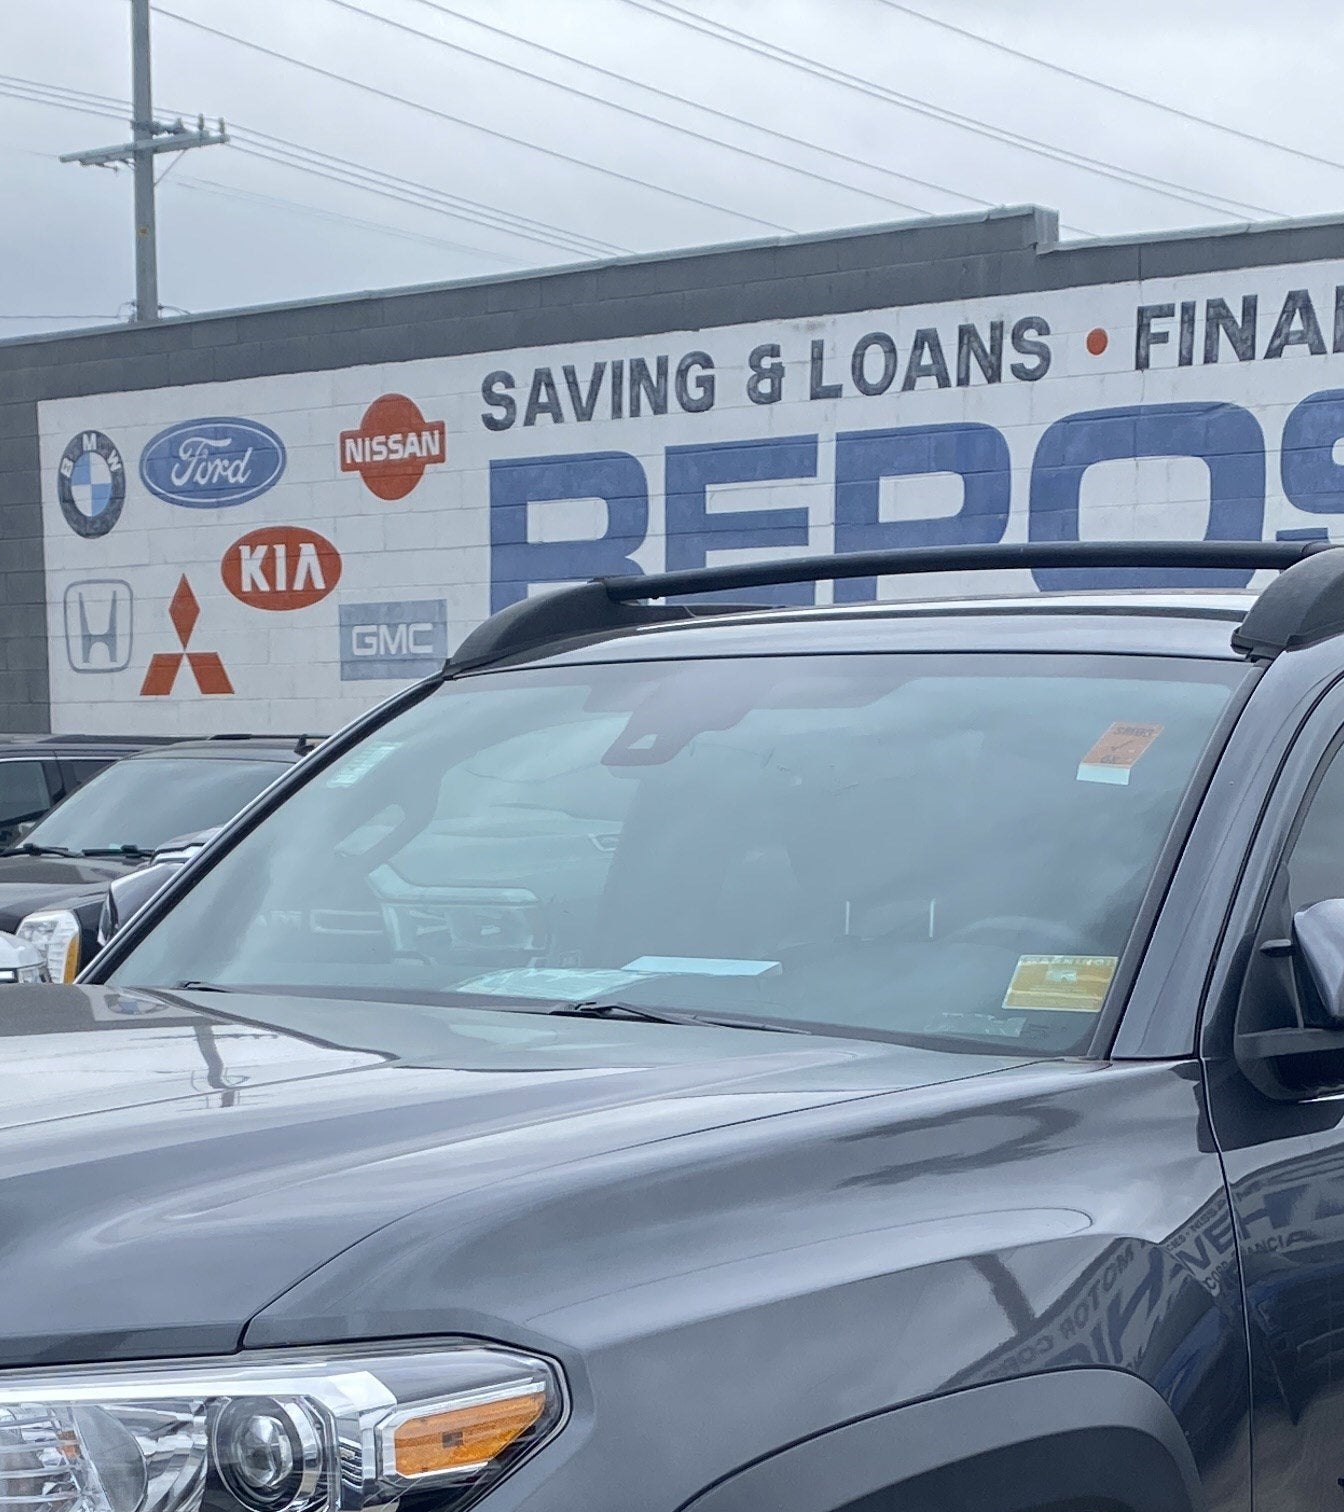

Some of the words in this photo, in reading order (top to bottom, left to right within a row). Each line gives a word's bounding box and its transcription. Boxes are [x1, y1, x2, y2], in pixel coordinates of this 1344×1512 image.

[481, 350, 716, 431] SAVING
[746, 343, 785, 405] &
[809, 316, 1052, 400] LOANS
[169, 436, 253, 488] Ford
[343, 428, 441, 465] NISSAN
[238, 542, 326, 592] KIA
[351, 622, 435, 656] GMC
